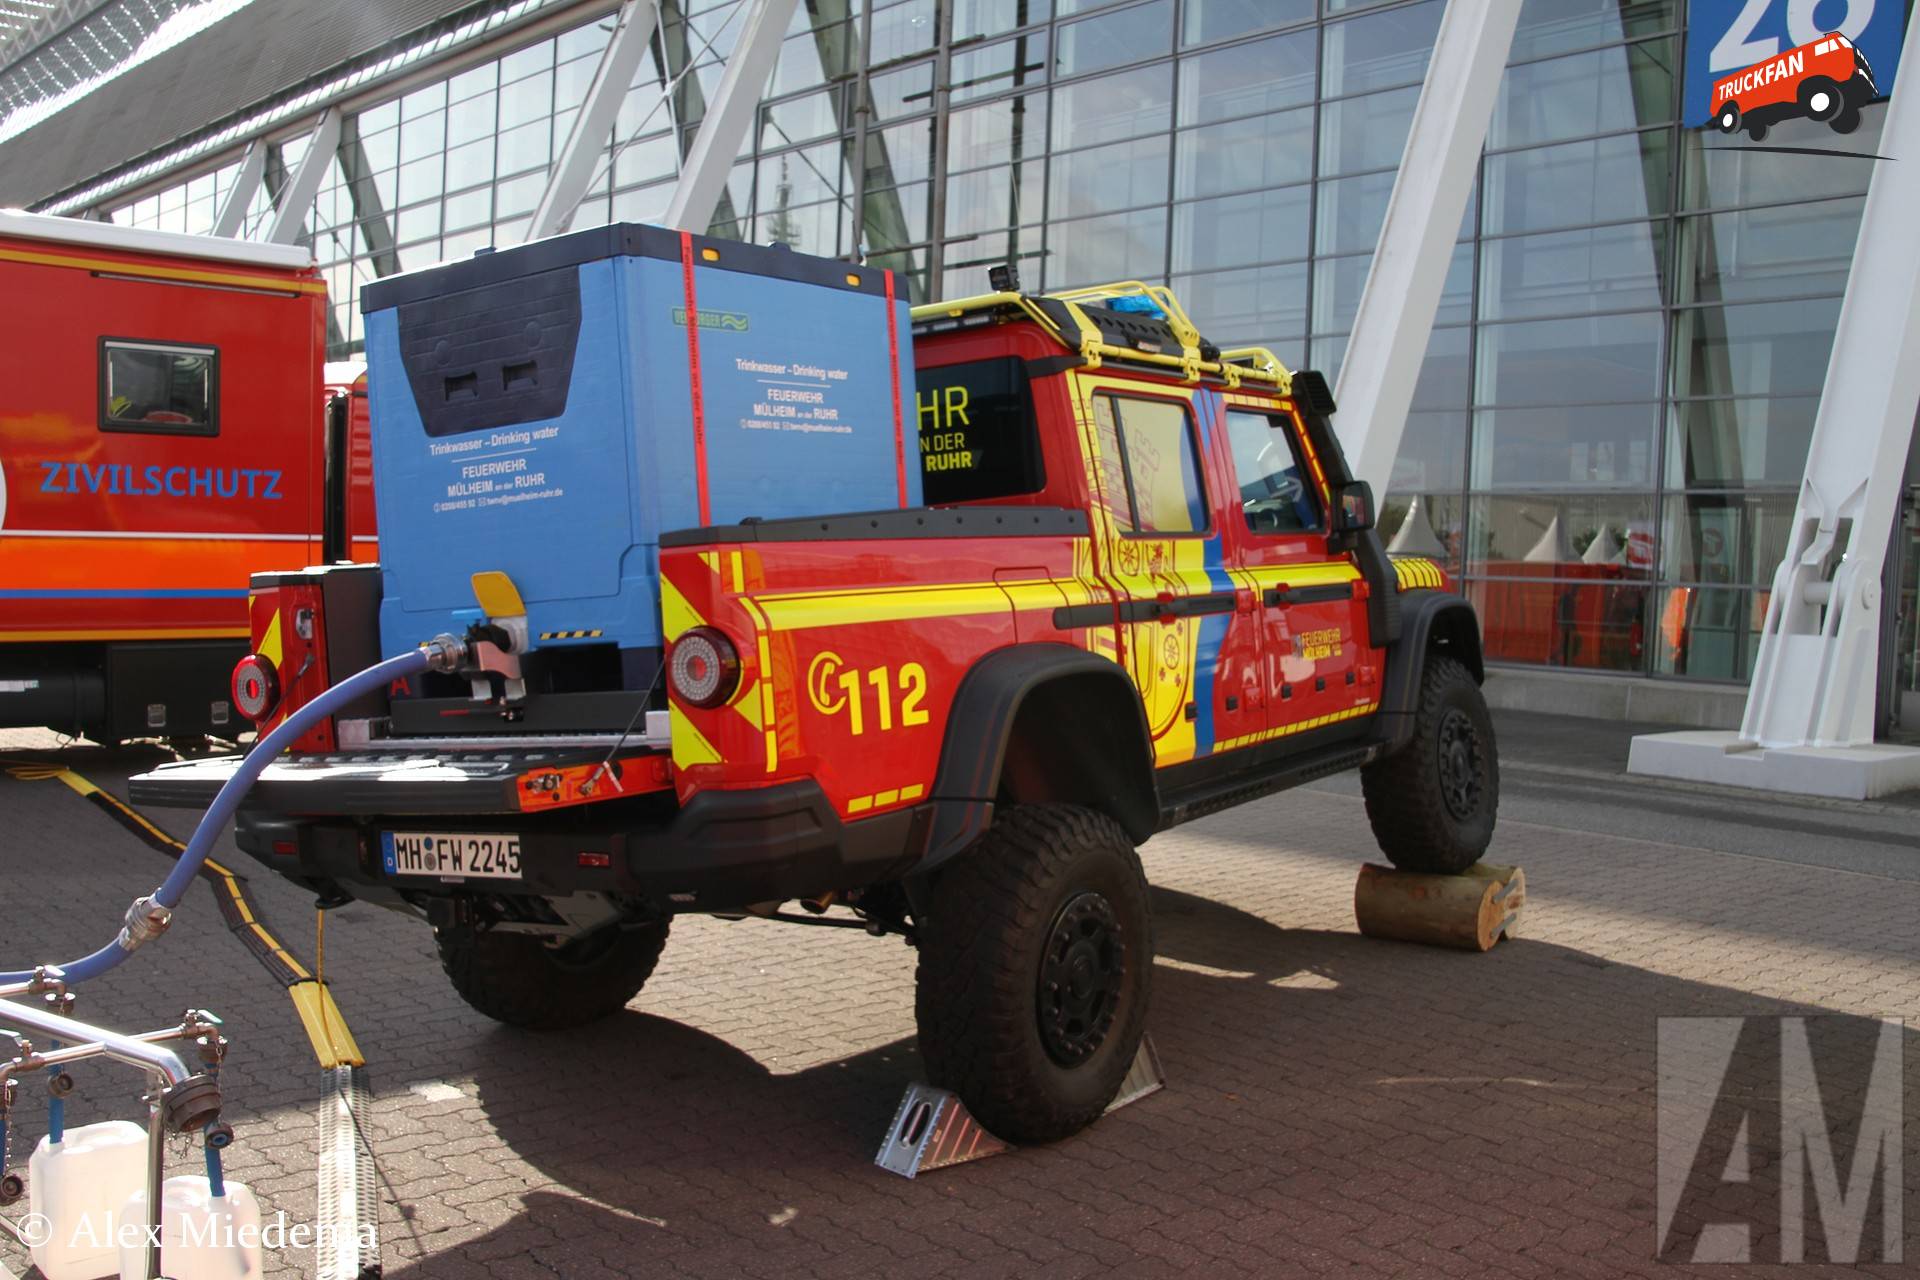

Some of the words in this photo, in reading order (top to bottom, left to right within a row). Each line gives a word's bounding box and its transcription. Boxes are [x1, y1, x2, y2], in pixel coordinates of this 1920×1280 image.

[736, 358, 786, 374] Trinkwasser
[793, 364, 826, 381] Drinking
[827, 369, 849, 380] water
[767, 388, 824, 404] FEUERWEHR
[753, 402, 796, 418] MÜLHEIM
[813, 407, 838, 421] RUHR
[430, 439, 483, 456] Trinkwasser
[491, 430, 530, 446] Drinking
[532, 426, 559, 440] water
[933, 432, 965, 451] DER
[462, 458, 527, 479] FEUERWEHR
[926, 451, 973, 472] RUHR
[40, 461, 283, 499] ZIVILSCHUTZ
[447, 480, 493, 497] MÜLHEIM
[514, 473, 545, 488] RUHR
[839, 662, 929, 735] 112
[395, 838, 422, 870] MH
[437, 839, 463, 871] FW
[468, 840, 521, 873] 2245
